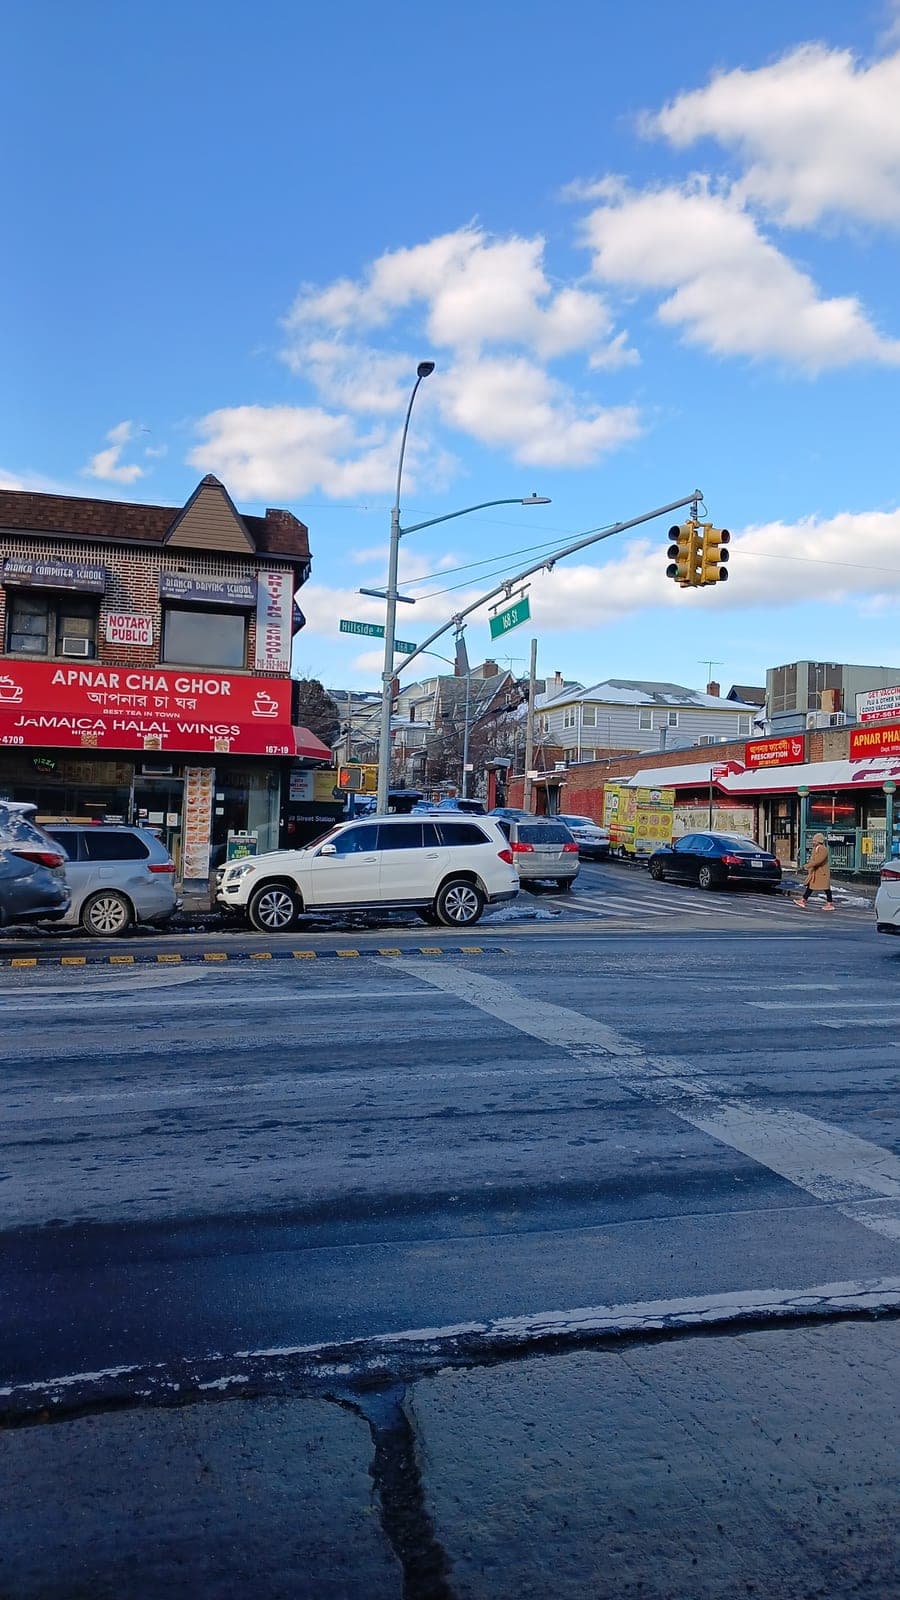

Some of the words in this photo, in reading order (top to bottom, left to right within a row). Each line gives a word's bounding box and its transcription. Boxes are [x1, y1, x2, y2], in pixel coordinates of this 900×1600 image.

[36, 566, 73, 577] COMPUTER
[77, 570, 103, 580] SCHOOL
[196, 581, 223, 592] DRIVING
[227, 584, 252, 595] SCHOOL
[267, 575, 282, 618] DRIVING
[109, 615, 151, 629] NOTARY
[503, 612, 511, 629] 168
[511, 609, 518, 624] St
[342, 621, 374, 635] Hillside
[111, 629, 148, 642] PUBLIC
[266, 622, 281, 659] SCHOOL
[51, 669, 120, 689] APNAR
[126, 674, 169, 691] CHA
[174, 677, 231, 696] GHOR
[86, 691, 148, 707] আপনার
[153, 695, 169, 709] চা
[174, 697, 197, 710] ঘর
[868, 691, 879, 699] GET
[113, 720, 171, 732] HALAL
[176, 723, 241, 736] WINGS
[853, 732, 881, 747] APNAR
[882, 730, 900, 744] PHA
[265, 745, 289, 754] 167-19
[751, 751, 788, 761] PRESCRIPTION
